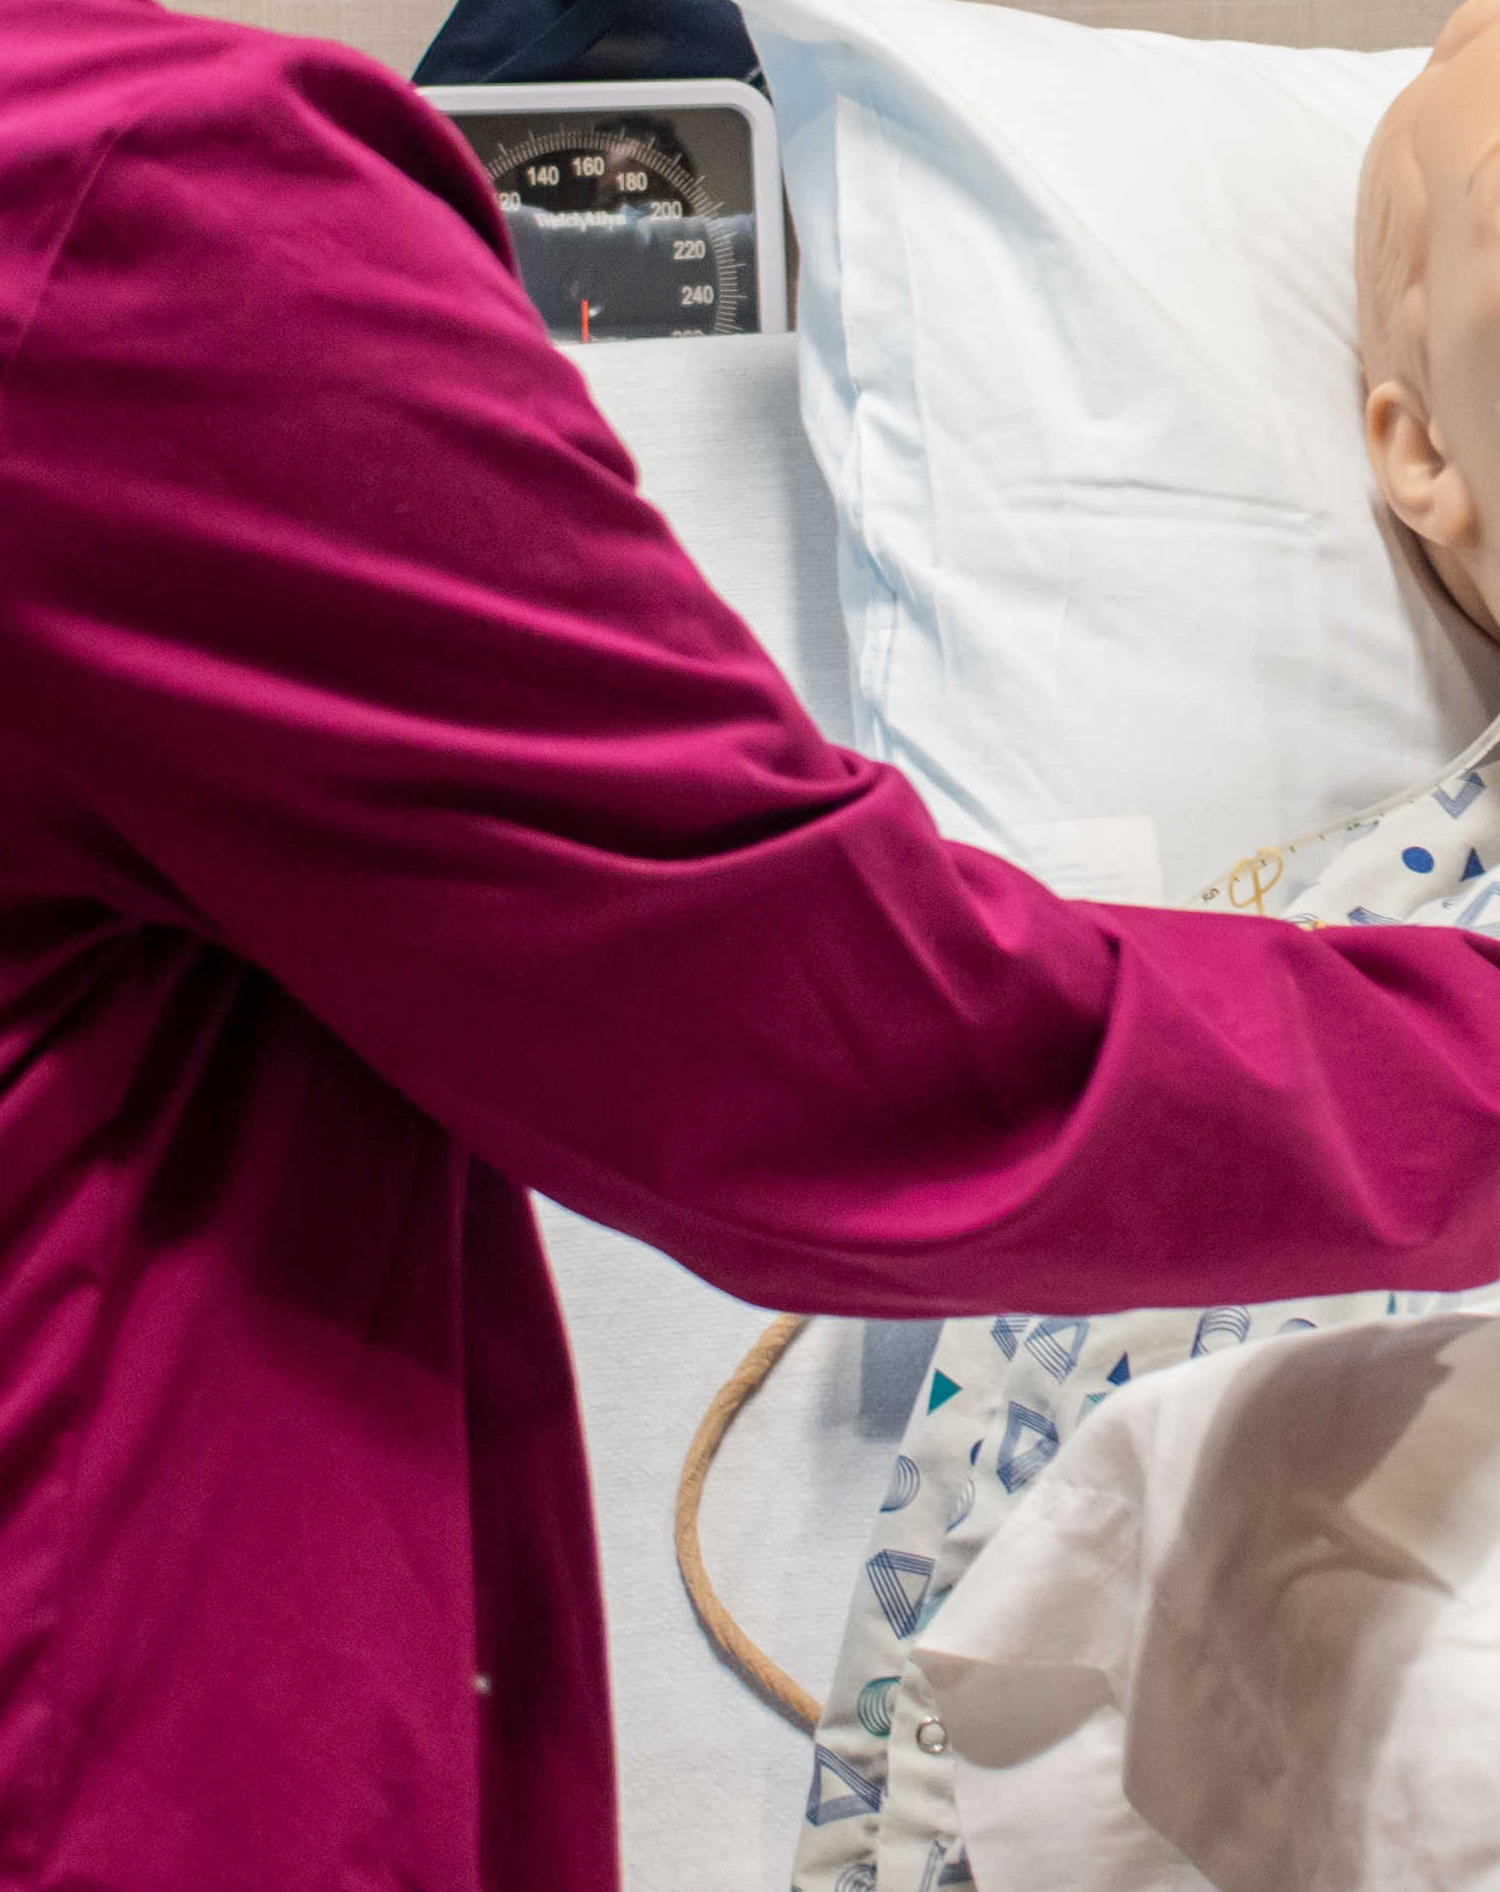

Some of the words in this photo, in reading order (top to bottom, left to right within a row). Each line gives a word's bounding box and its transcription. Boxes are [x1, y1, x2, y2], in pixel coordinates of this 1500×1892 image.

[527, 166, 560, 186] 140
[573, 157, 606, 177] 160
[616, 171, 649, 192] 180
[499, 191, 521, 212] 20
[650, 200, 683, 221] 200
[673, 240, 707, 261] 220
[680, 285, 715, 306] 240
